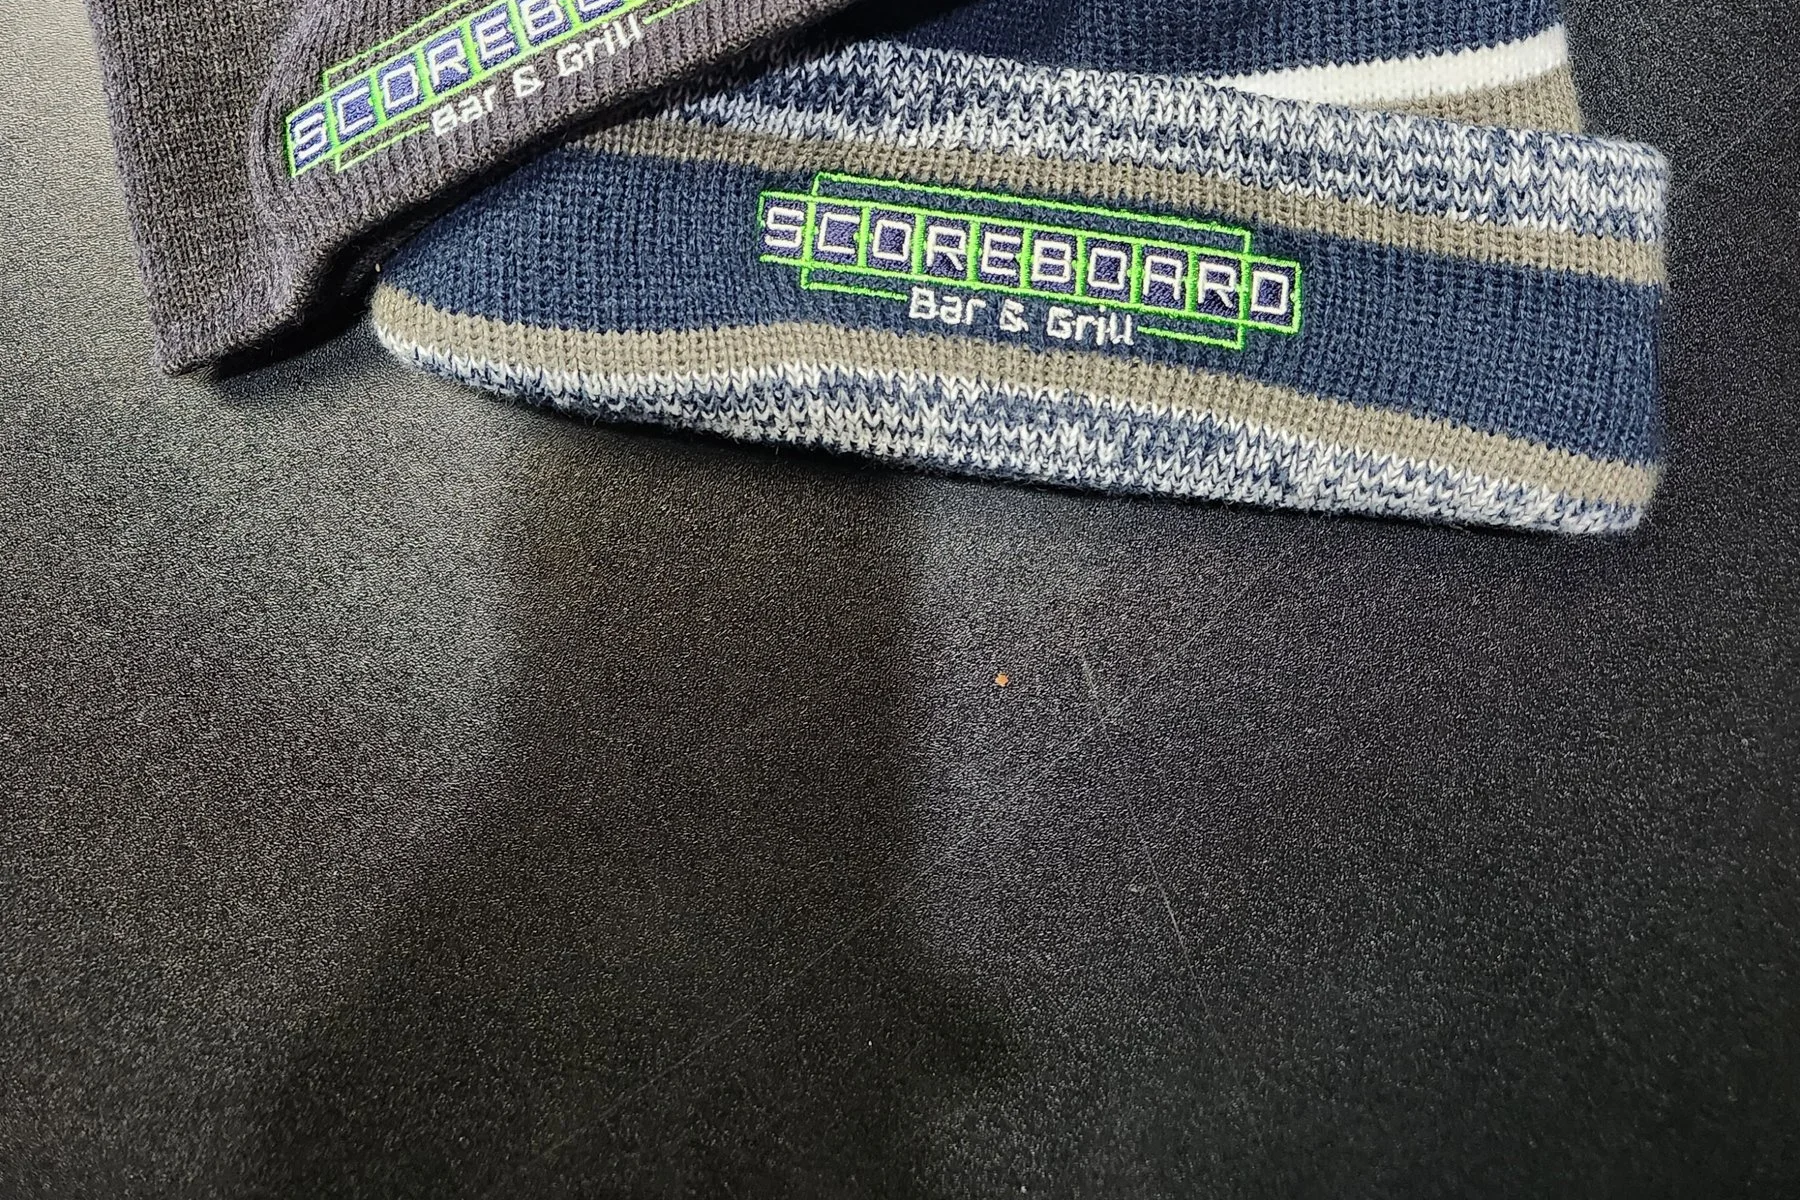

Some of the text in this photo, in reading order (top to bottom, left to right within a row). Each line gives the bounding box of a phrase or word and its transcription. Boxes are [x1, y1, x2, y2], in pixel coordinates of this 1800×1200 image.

[431, 13, 644, 138] Bar & Grill
[765, 205, 1291, 315] SCOREBOARD
[908, 286, 1135, 347] Bar & Grill
